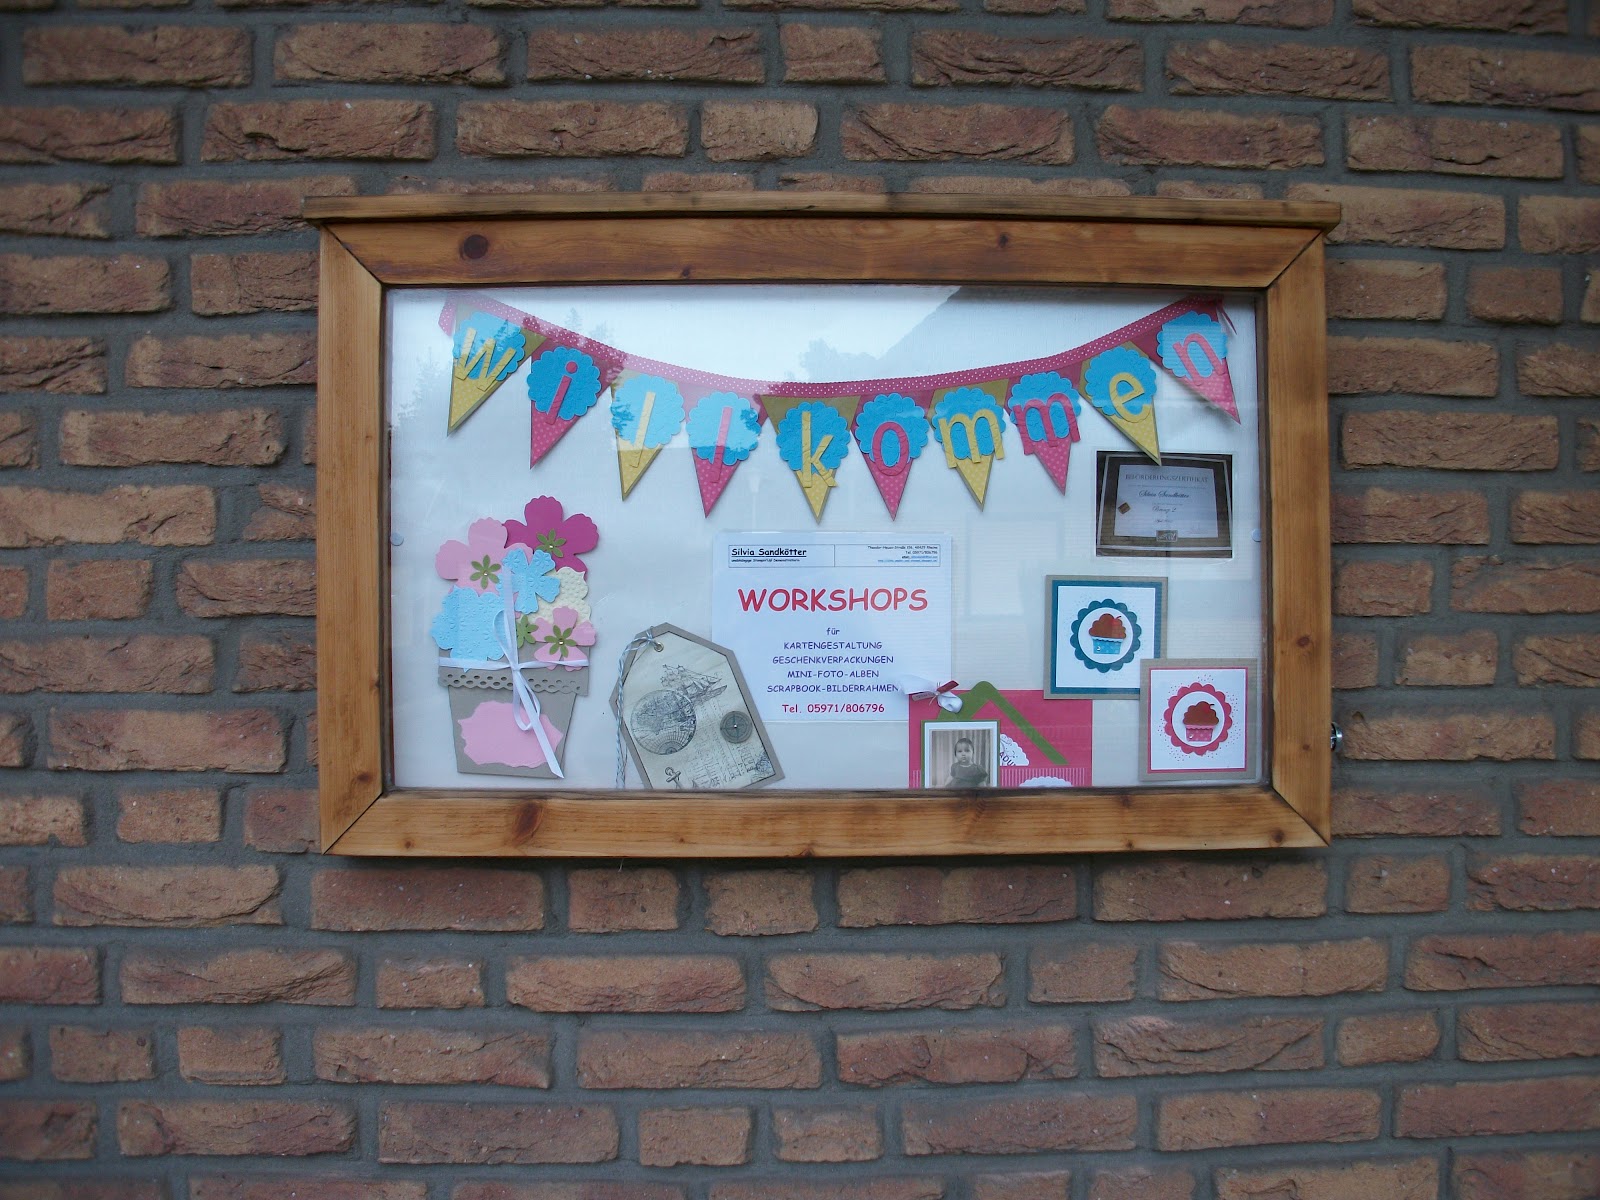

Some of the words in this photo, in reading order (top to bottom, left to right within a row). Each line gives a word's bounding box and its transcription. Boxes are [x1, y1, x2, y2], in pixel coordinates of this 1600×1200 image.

[731, 548, 755, 556] Silvia
[758, 548, 807, 556] Sandkötter
[737, 587, 928, 612] WORKSHOPS
[826, 627, 840, 636] für
[783, 641, 883, 650] KARTENGESTALTUNG
[772, 655, 894, 665] GESCHENKVERPACKUNGEN
[787, 669, 880, 679] MINI-FOTO-ALBEN
[766, 684, 899, 693] SCRAPBOOK-BILDERRAHMEN
[782, 704, 802, 714] Tel.
[807, 703, 885, 713] 05971/806796
